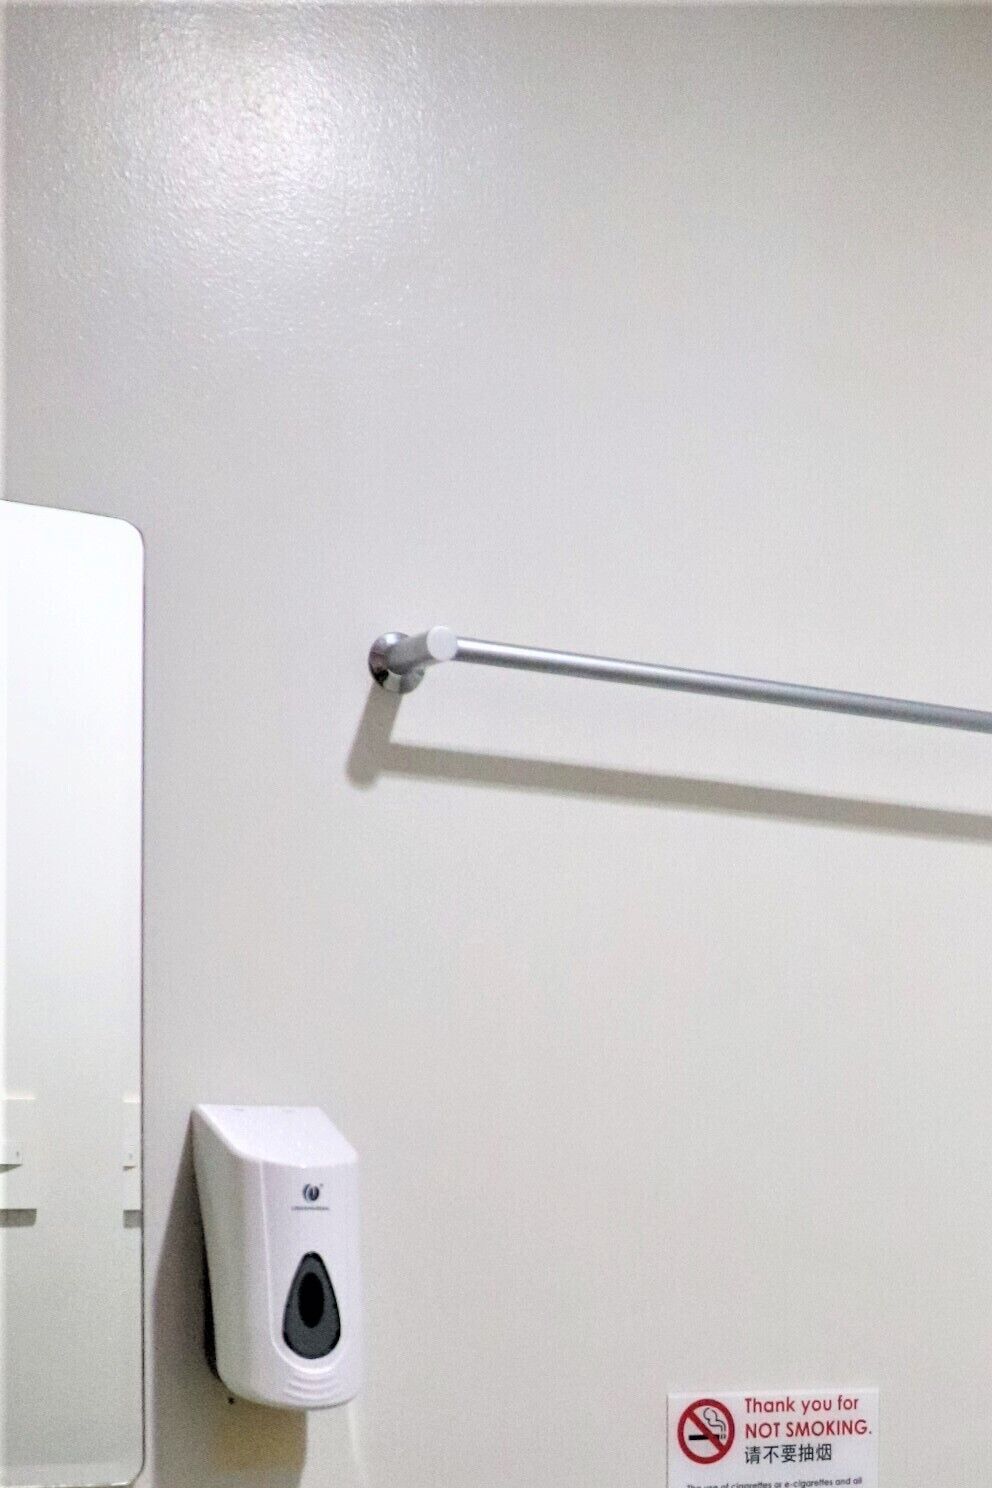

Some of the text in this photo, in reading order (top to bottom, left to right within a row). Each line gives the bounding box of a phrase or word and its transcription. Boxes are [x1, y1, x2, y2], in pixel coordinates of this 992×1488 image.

[745, 1395, 859, 1415] Thank you for
[745, 1419, 872, 1439] NOT SMOKING.
[745, 1443, 832, 1465] 请不要抽烟
[784, 1478, 833, 1488] e-cigarettes
[835, 1478, 851, 1486] and
[853, 1477, 862, 1485] all
